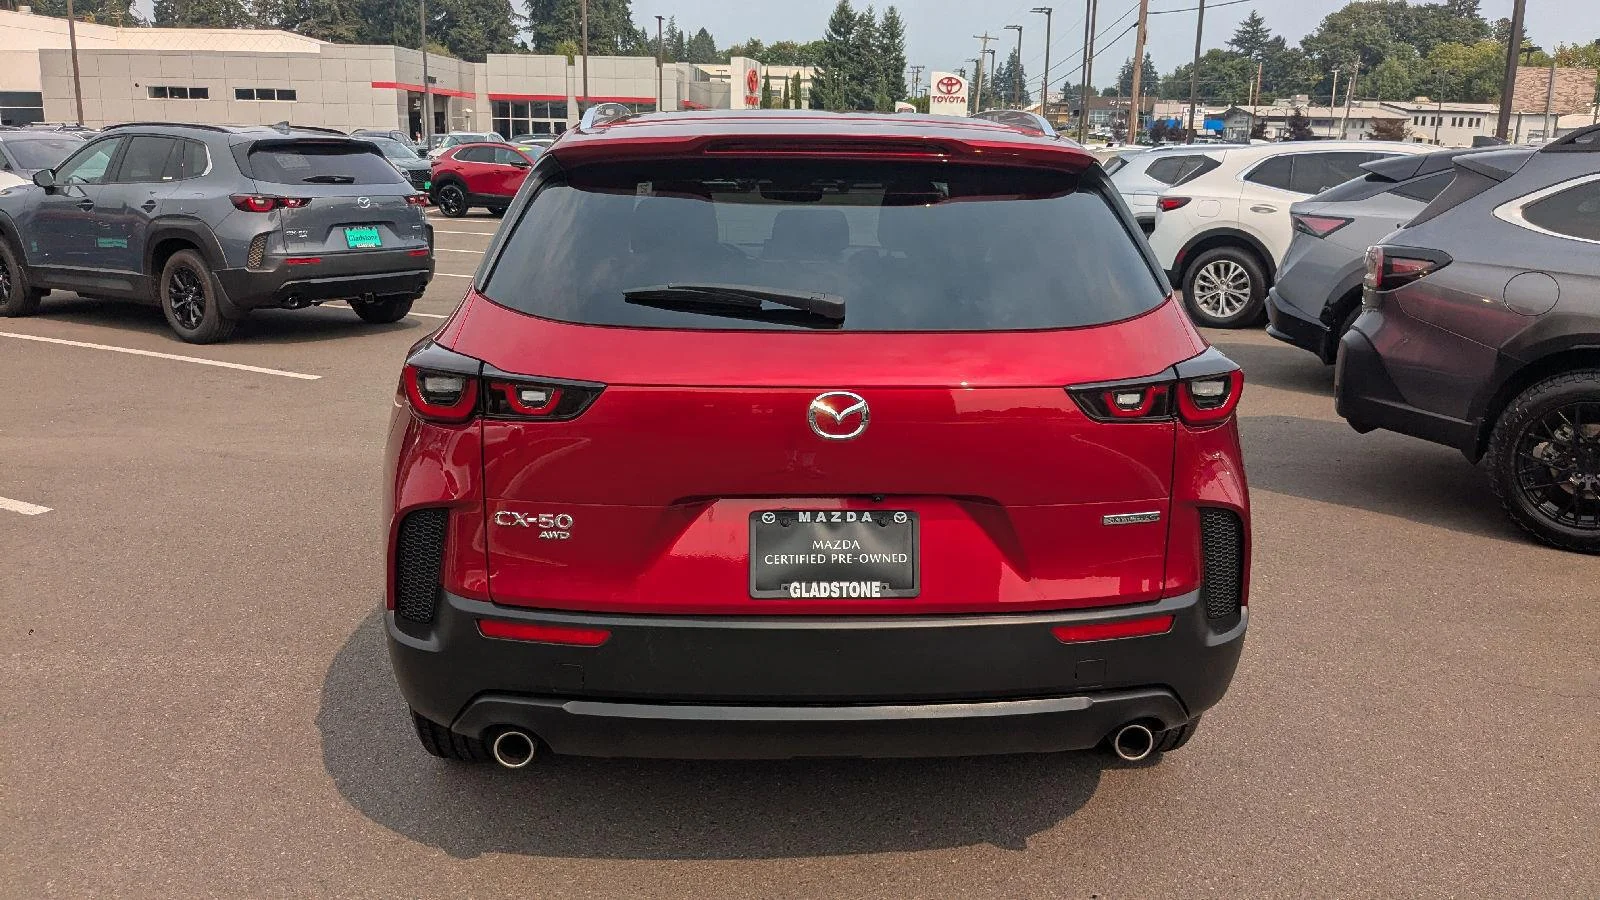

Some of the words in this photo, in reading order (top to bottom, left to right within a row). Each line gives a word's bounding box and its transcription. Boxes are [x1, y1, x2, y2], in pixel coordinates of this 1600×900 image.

[932, 95, 966, 104] TOYOTA
[494, 510, 574, 530] CX-50
[798, 511, 873, 523] MAZDA
[538, 530, 571, 540] AWD
[812, 539, 861, 550] MAZDA
[764, 554, 826, 565] CERTIFIED
[831, 553, 908, 564] PRE-OWNED
[789, 581, 881, 598] GLADSTONE
